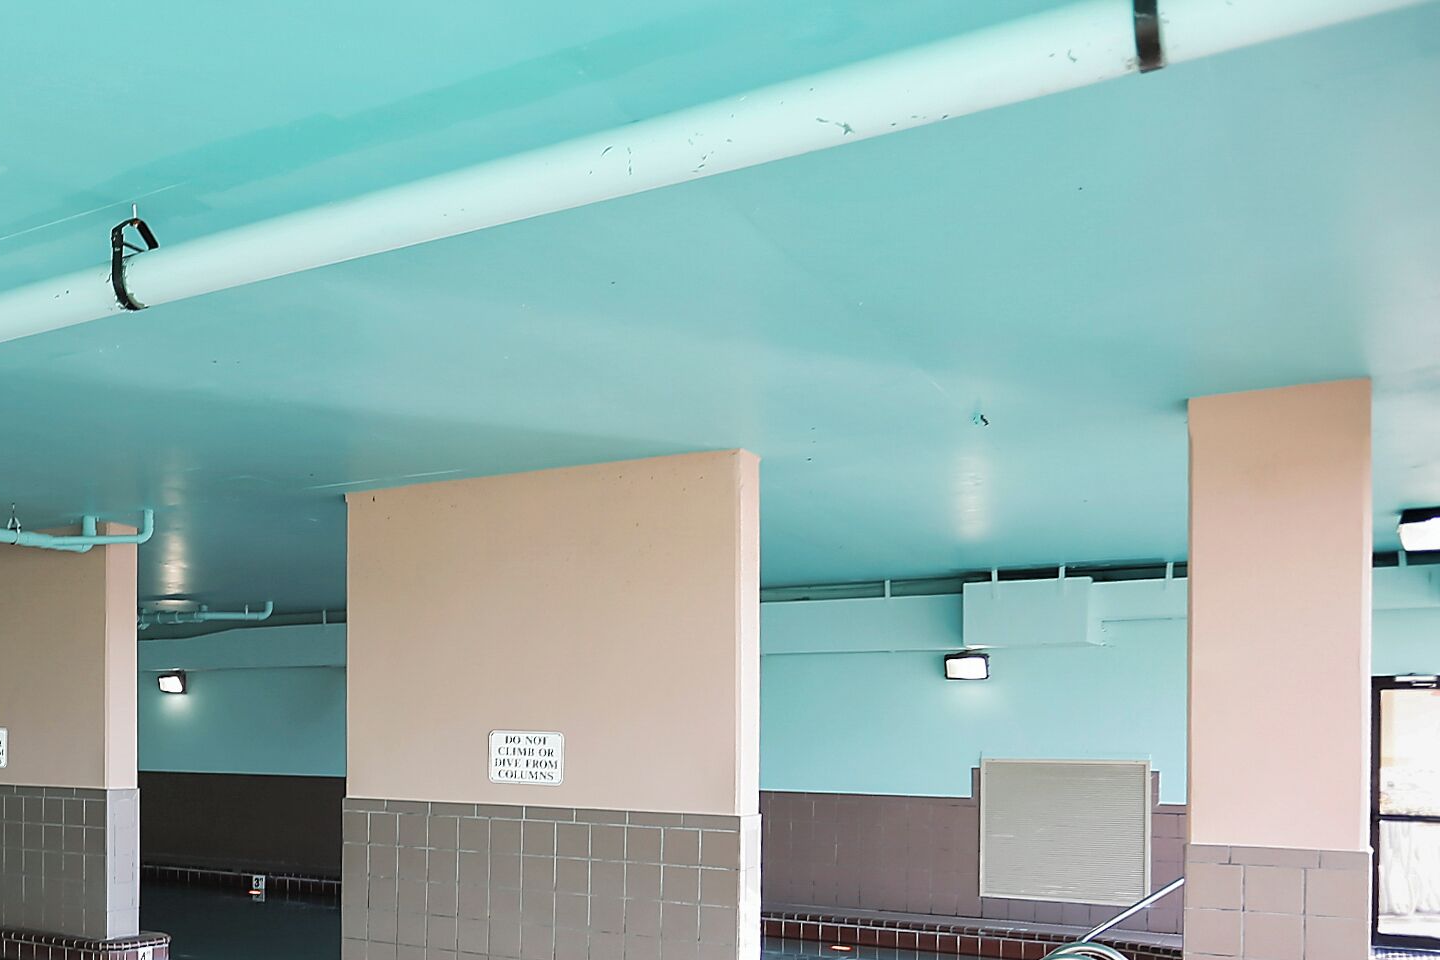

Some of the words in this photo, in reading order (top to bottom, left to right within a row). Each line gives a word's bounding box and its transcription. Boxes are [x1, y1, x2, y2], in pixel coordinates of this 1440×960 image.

[505, 735, 521, 744] DO
[526, 736, 548, 745] NOT
[498, 746, 534, 756] CLIMB
[538, 748, 554, 757] OR
[494, 758, 521, 767] DIVE
[526, 759, 558, 769] FROM
[498, 769, 554, 780] COLUMNS
